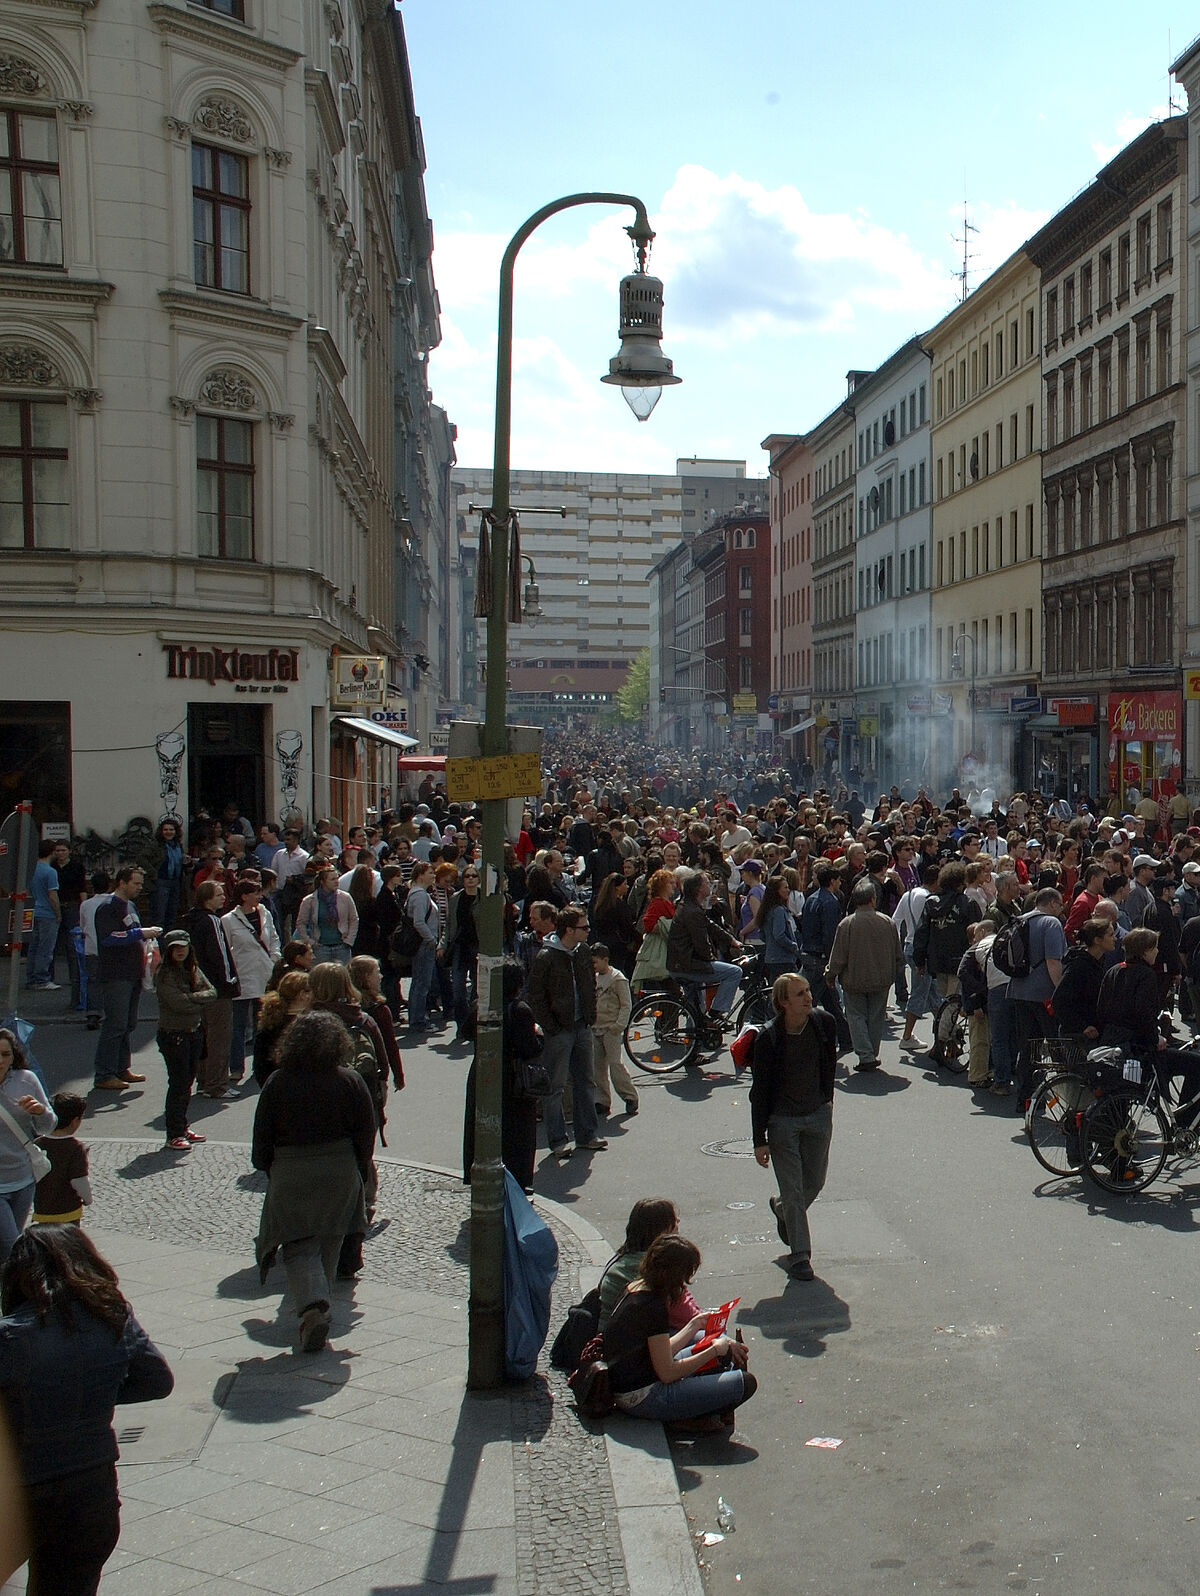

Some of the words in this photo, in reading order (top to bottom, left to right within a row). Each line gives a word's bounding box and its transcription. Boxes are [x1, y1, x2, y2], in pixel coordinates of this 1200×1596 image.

[162, 644, 300, 686] Trinkteufel
[340, 683, 362, 694] Berliner
[1138, 703, 1177, 731] Bäckerei
